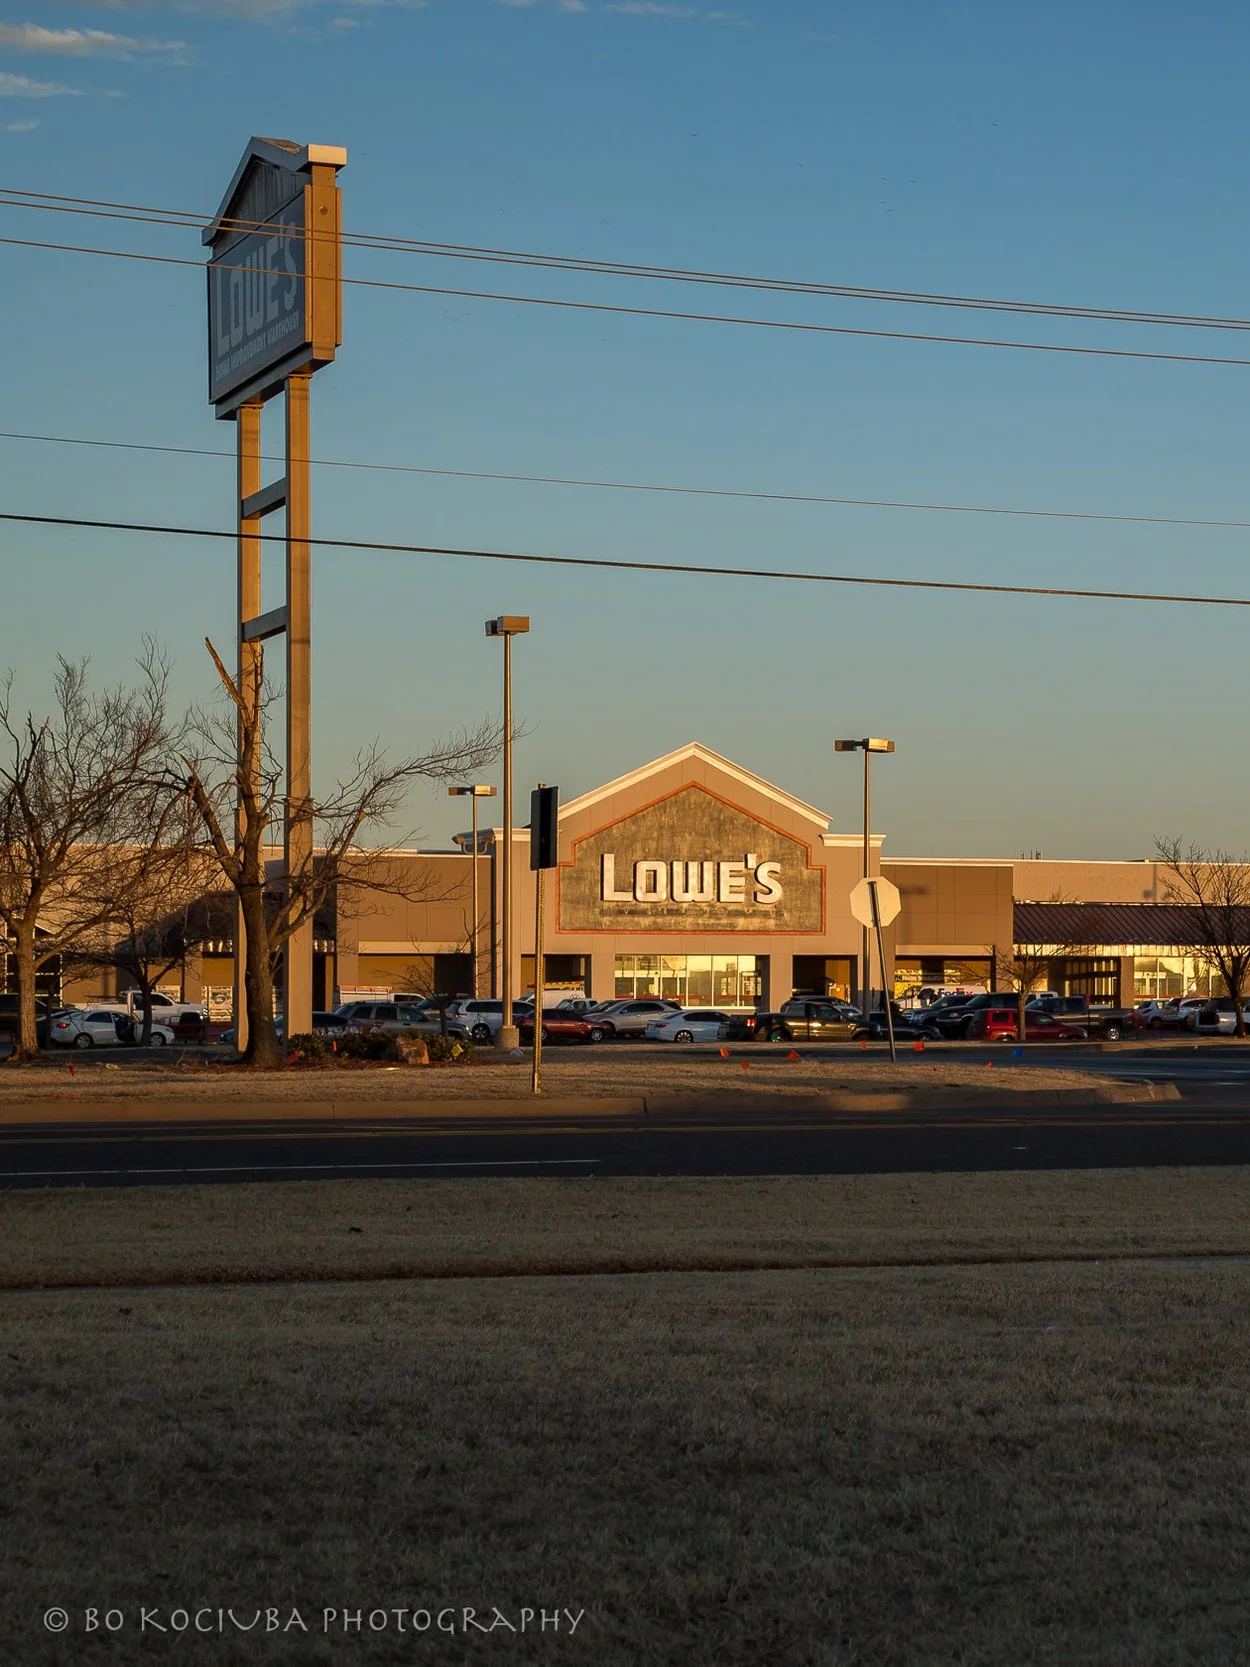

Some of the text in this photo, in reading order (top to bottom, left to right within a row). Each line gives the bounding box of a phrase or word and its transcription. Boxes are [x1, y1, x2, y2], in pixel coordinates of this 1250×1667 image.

[216, 215, 298, 358] LOWE'S
[230, 332, 267, 372] IMPROVEMENT
[266, 309, 300, 345] WAREHOUSE
[601, 853, 783, 904] LOWE'S
